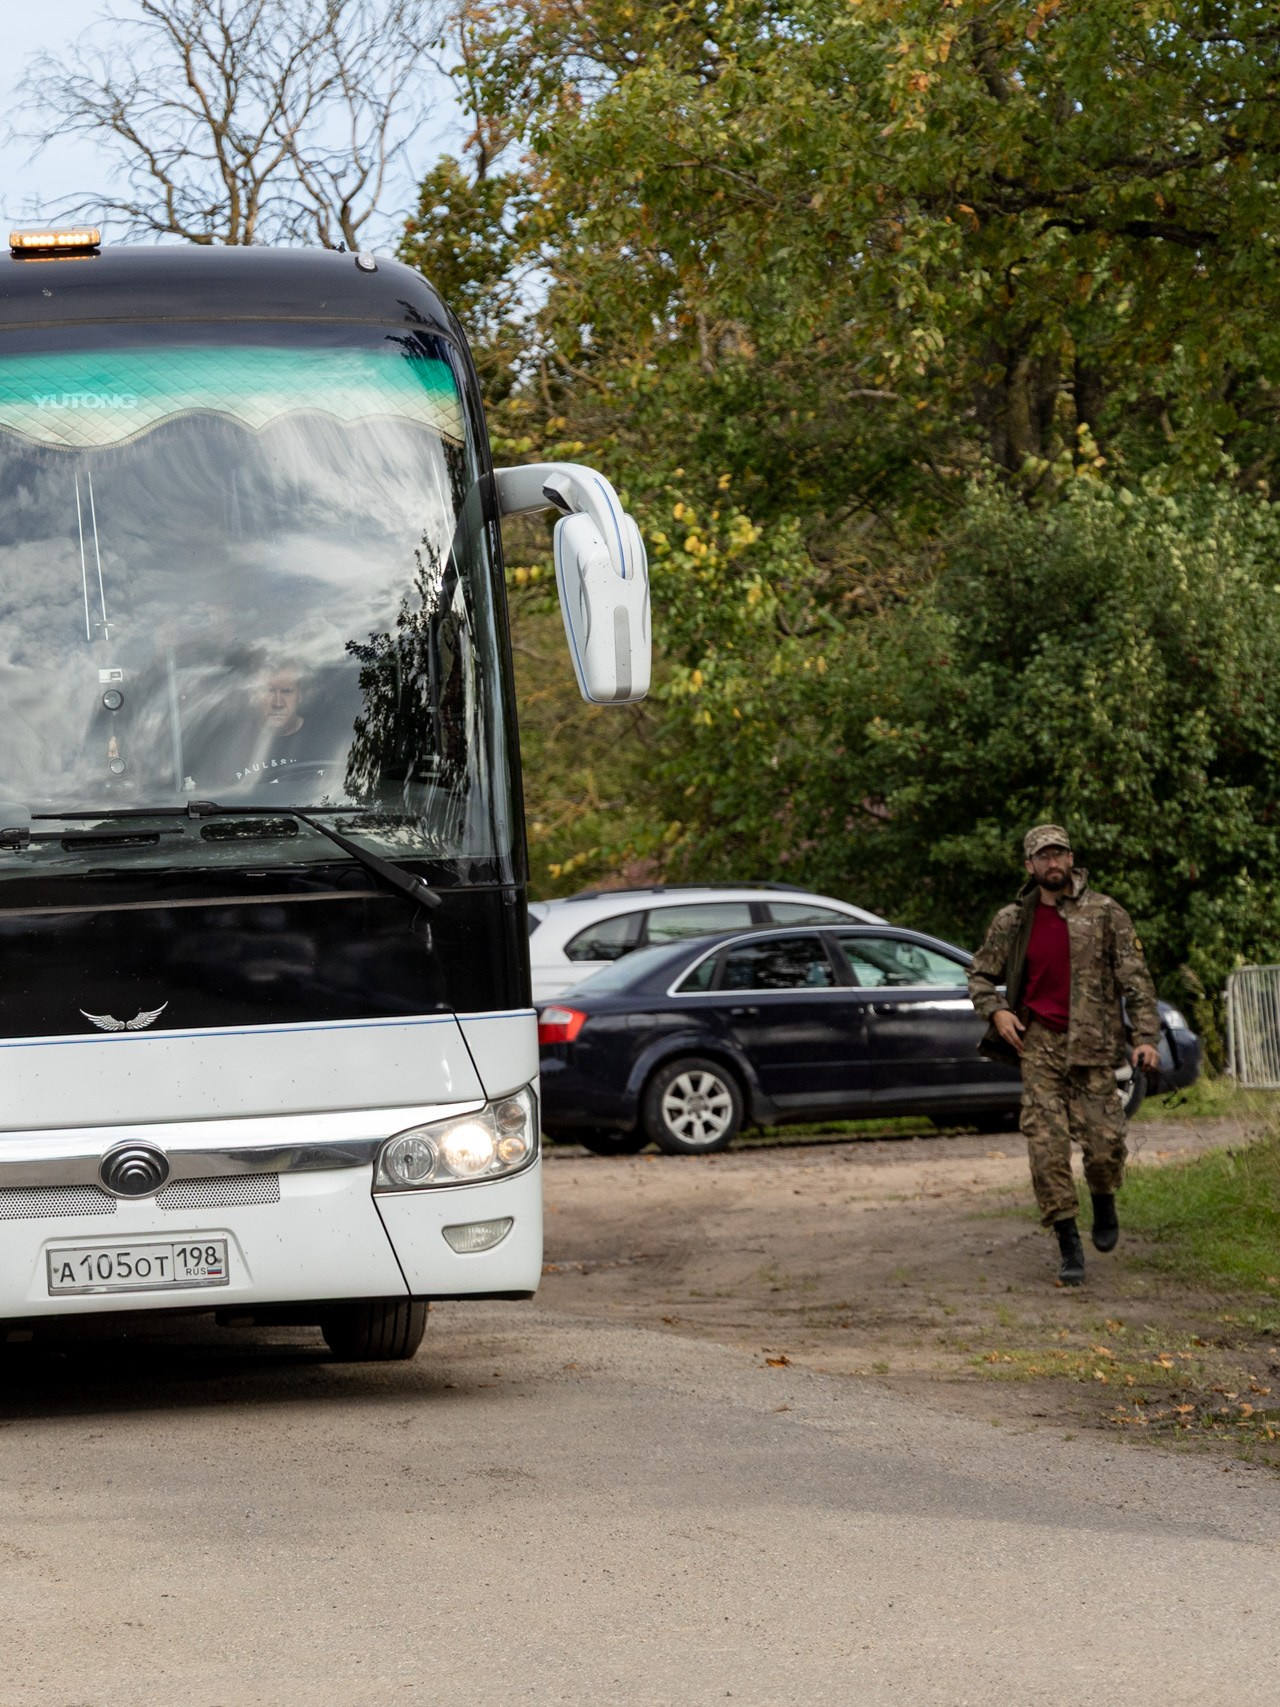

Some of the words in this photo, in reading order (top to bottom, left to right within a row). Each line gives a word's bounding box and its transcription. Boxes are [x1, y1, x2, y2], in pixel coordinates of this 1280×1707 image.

[31, 393, 138, 409] YUTONG
[176, 1246, 219, 1267] 198
[185, 1267, 207, 1276] RUS
